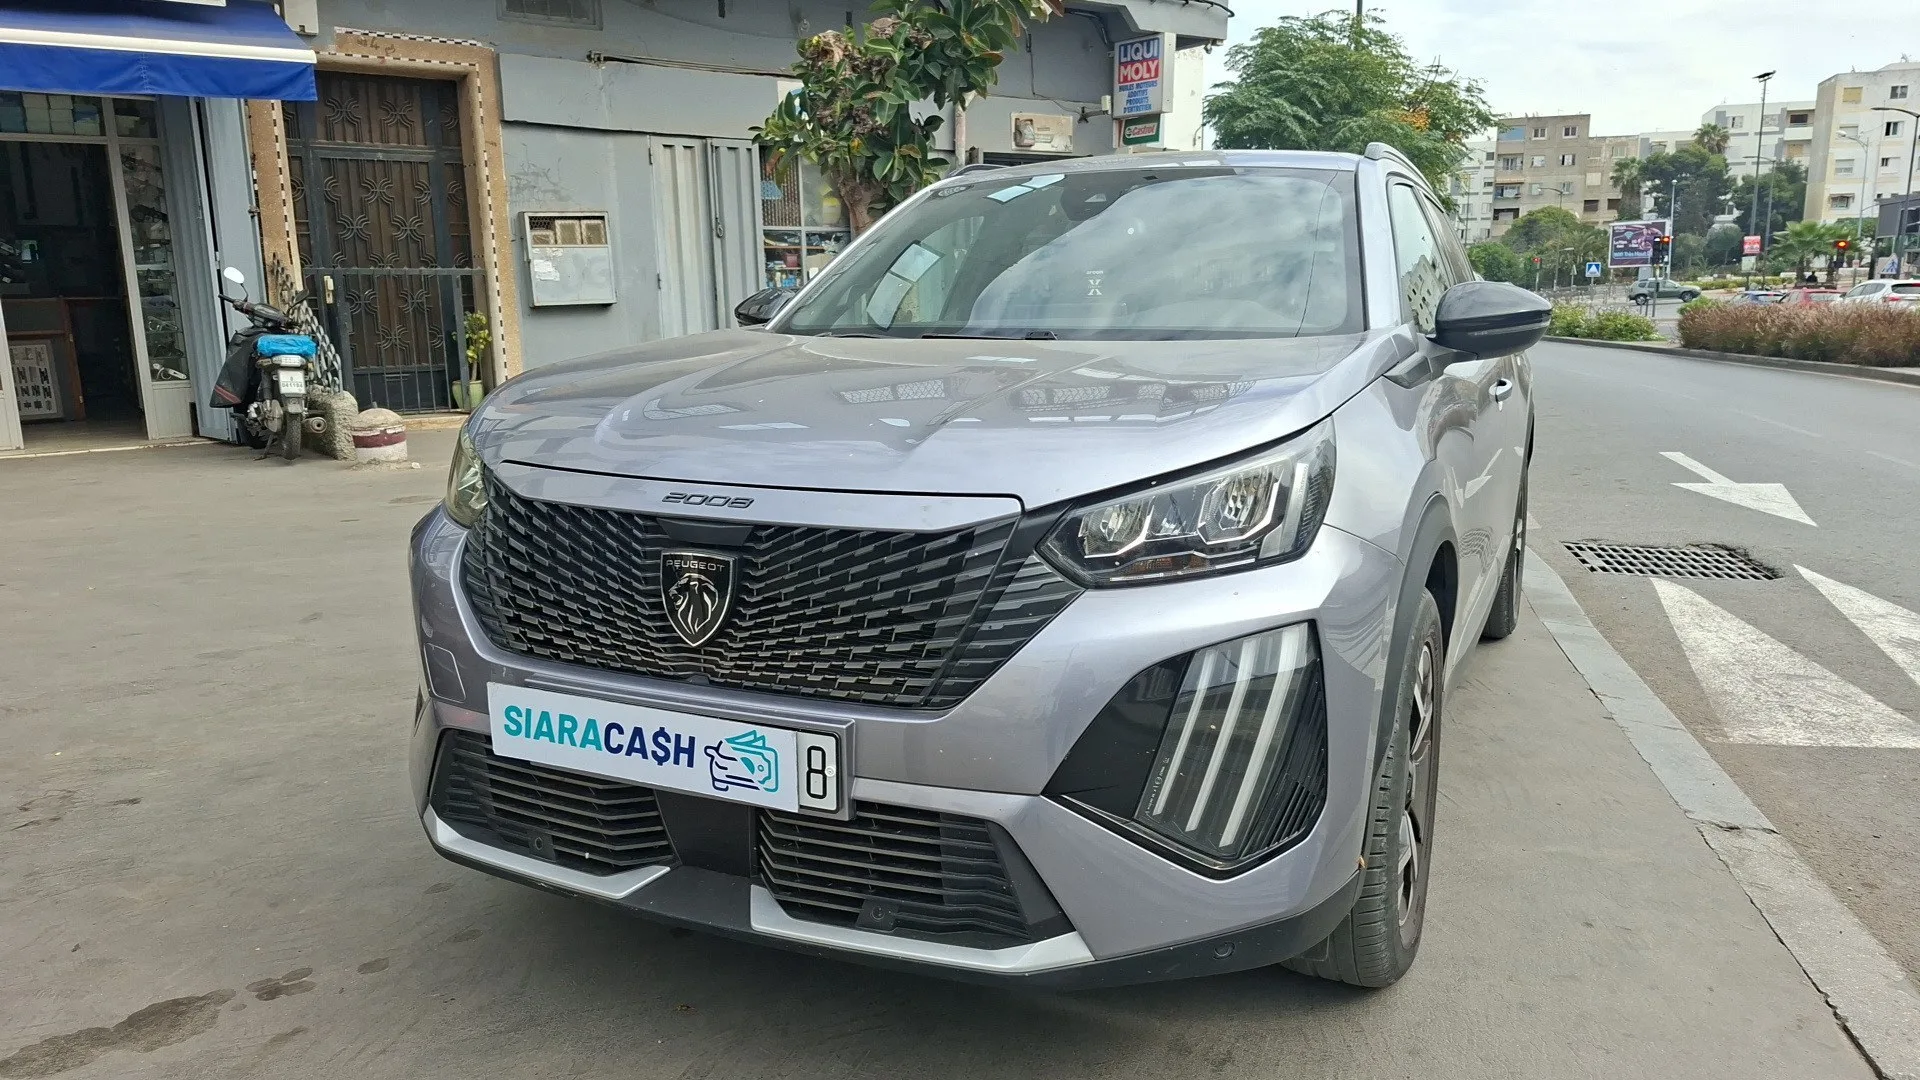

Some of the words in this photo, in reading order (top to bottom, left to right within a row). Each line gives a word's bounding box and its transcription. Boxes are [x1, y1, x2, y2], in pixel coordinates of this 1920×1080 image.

[1120, 39, 1158, 62] LIQUI
[1120, 60, 1159, 82] MOLY
[1132, 125, 1156, 136] Castrol
[662, 492, 755, 509] 2008
[665, 559, 726, 572] PEUGEOT
[806, 744, 828, 800] 8
